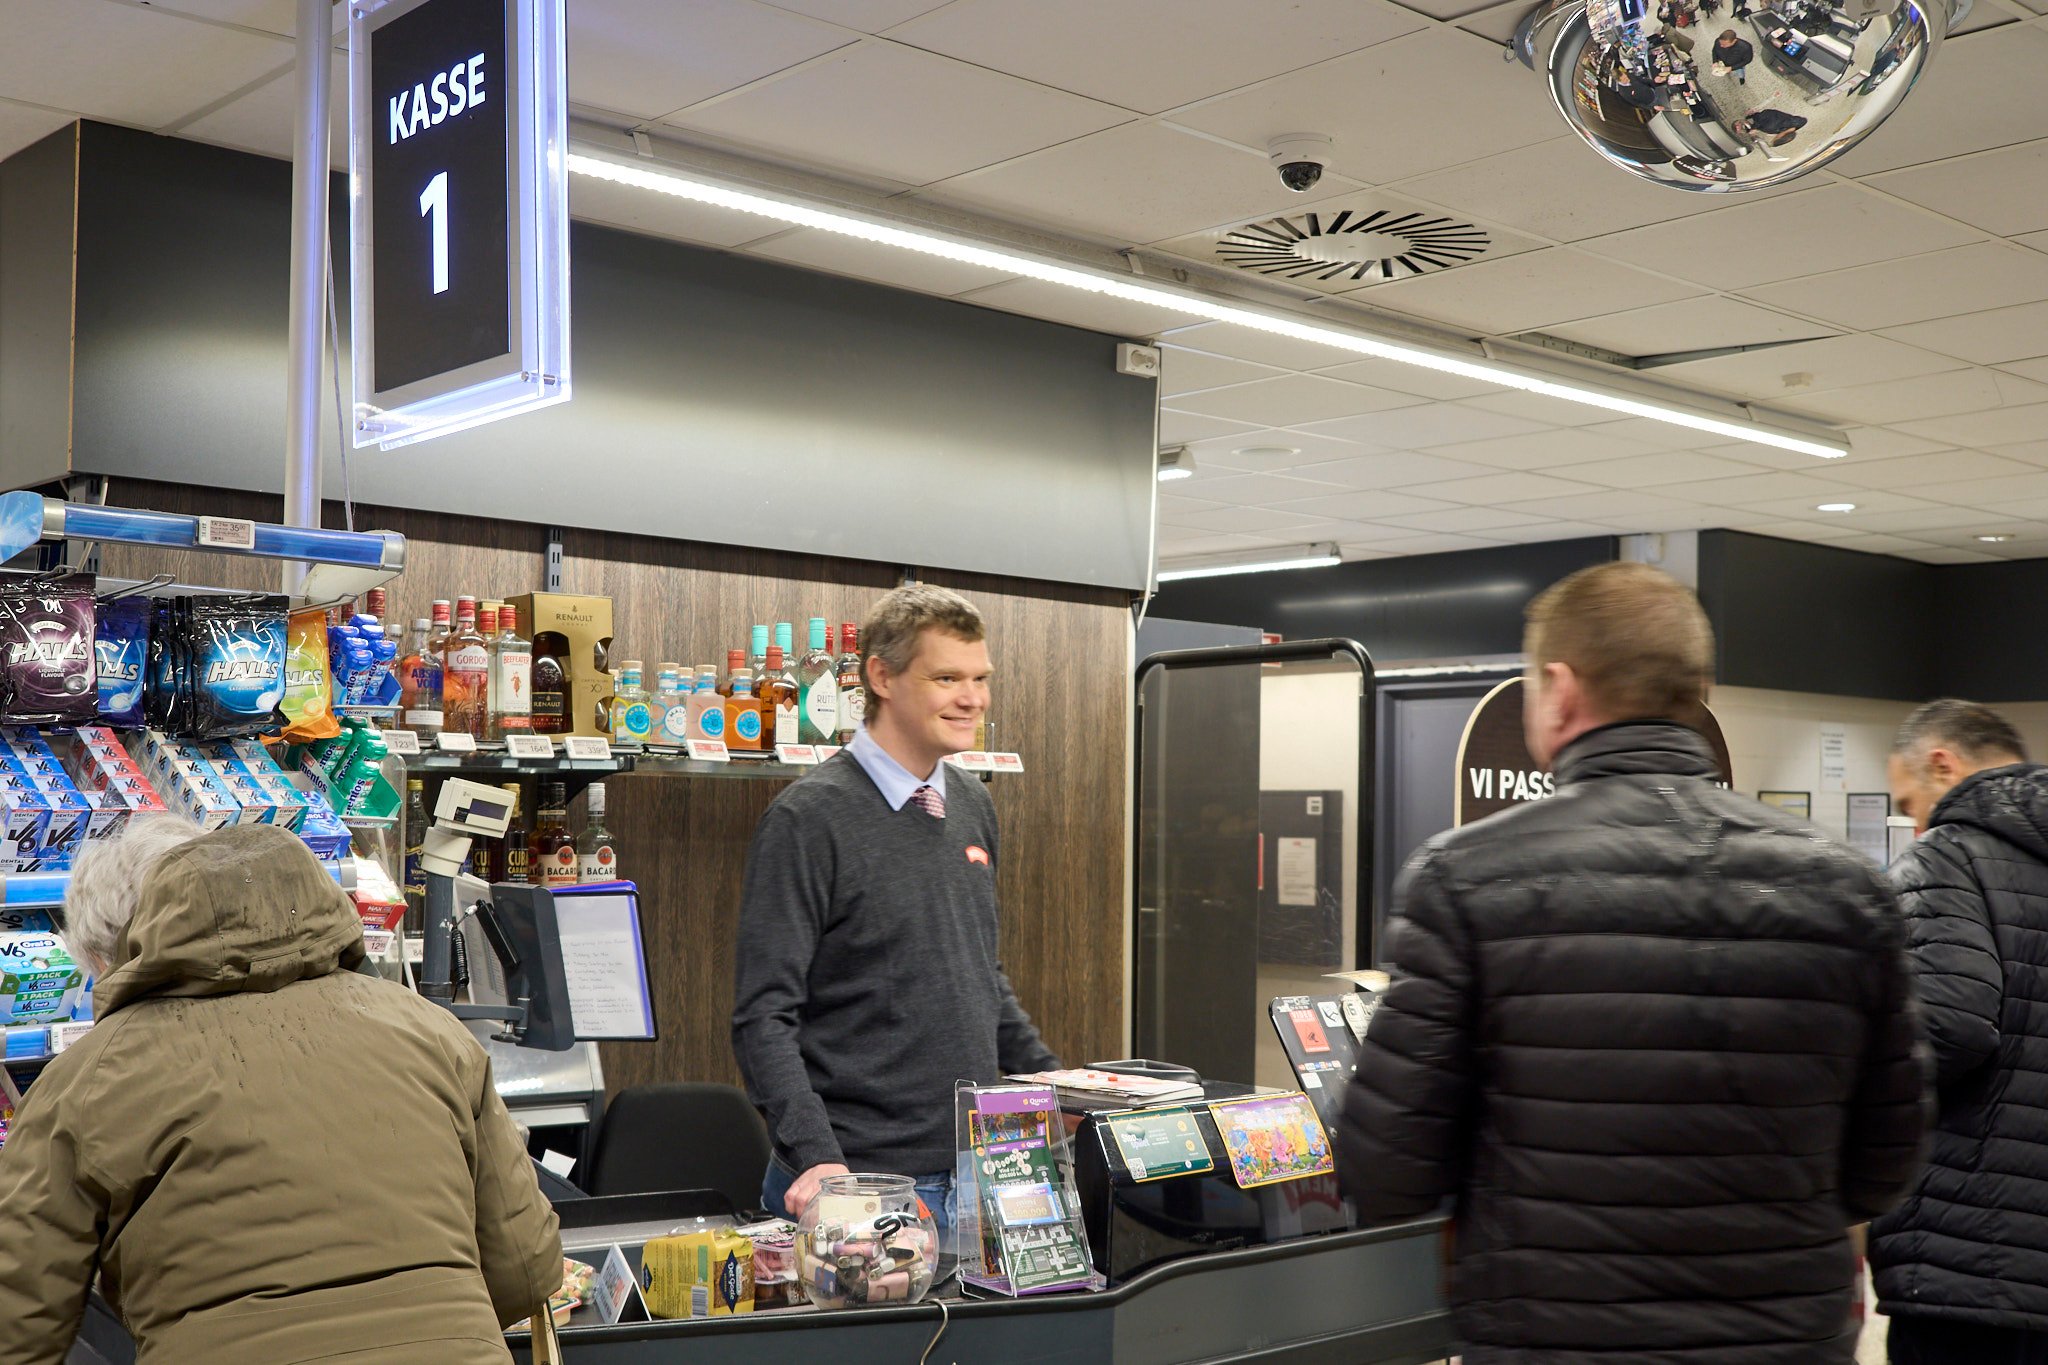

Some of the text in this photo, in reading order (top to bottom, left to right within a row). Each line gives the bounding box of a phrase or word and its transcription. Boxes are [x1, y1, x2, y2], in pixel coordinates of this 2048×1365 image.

[389, 53, 486, 145] KASSE
[419, 171, 449, 295] 1
[556, 614, 593, 622] RENAULT
[7, 641, 89, 667] HALLS
[503, 655, 530, 664] BEEFEATER
[207, 660, 280, 684] HALLS
[90, 730, 106, 742] V6
[163, 733, 178, 742] V6
[101, 746, 118, 758] V6
[175, 746, 191, 758] V6
[36, 760, 53, 773] V6
[113, 762, 130, 774] V6
[158, 755, 168, 771] V6
[187, 761, 203, 774] V6
[222, 761, 238, 773] V6
[256, 761, 272, 772] V6
[7, 776, 24, 788] V6
[47, 777, 63, 789] V6
[125, 778, 141, 790] V6
[170, 771, 179, 787] V6
[199, 778, 215, 790] V6
[299, 763, 328, 793] mentos
[1470, 767, 1557, 801] VI PASS
[18, 793, 35, 804] V6
[58, 793, 75, 806] V6
[136, 794, 153, 807] V6
[182, 787, 191, 804] V6
[346, 778, 366, 816] entos
[193, 803, 203, 820] V6
[8, 820, 41, 853] V6
[507, 850, 529, 867] CUB
[0, 942, 26, 957] V6
[37, 971, 62, 979] PACK
[28, 981, 38, 991] V6
[30, 991, 55, 999] PACK
[22, 1001, 32, 1011] V6
[727, 1261, 736, 1301] Det Gode
